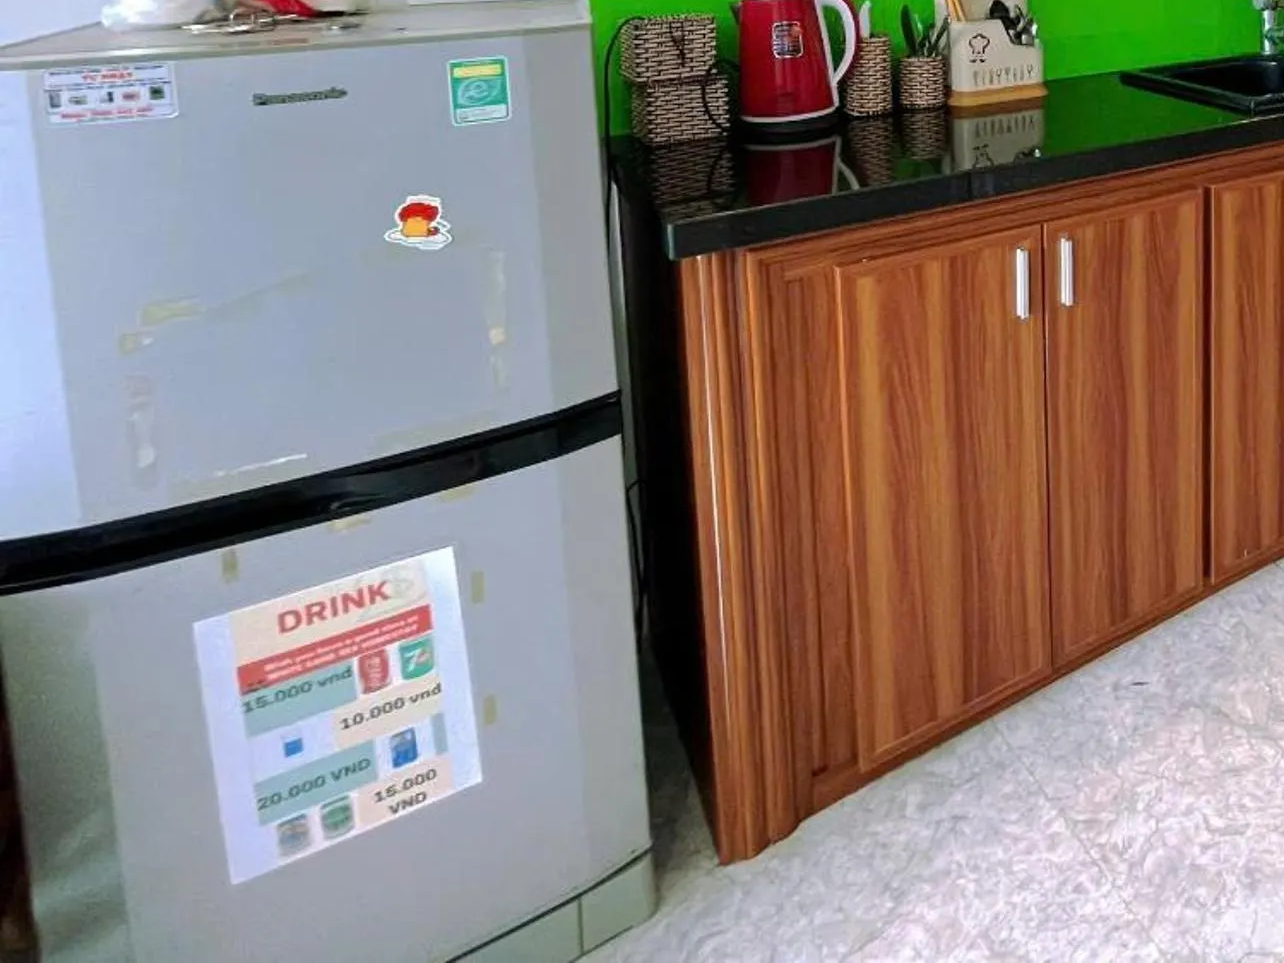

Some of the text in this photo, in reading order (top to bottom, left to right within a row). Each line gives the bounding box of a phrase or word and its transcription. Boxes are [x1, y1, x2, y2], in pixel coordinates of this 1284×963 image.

[277, 580, 393, 635] DRINK
[242, 680, 314, 714] 15.000
[316, 666, 354, 689] vnd
[339, 682, 442, 731] 10.000 vnd
[257, 758, 372, 812] 20.000 VND
[388, 791, 428, 816] VND
